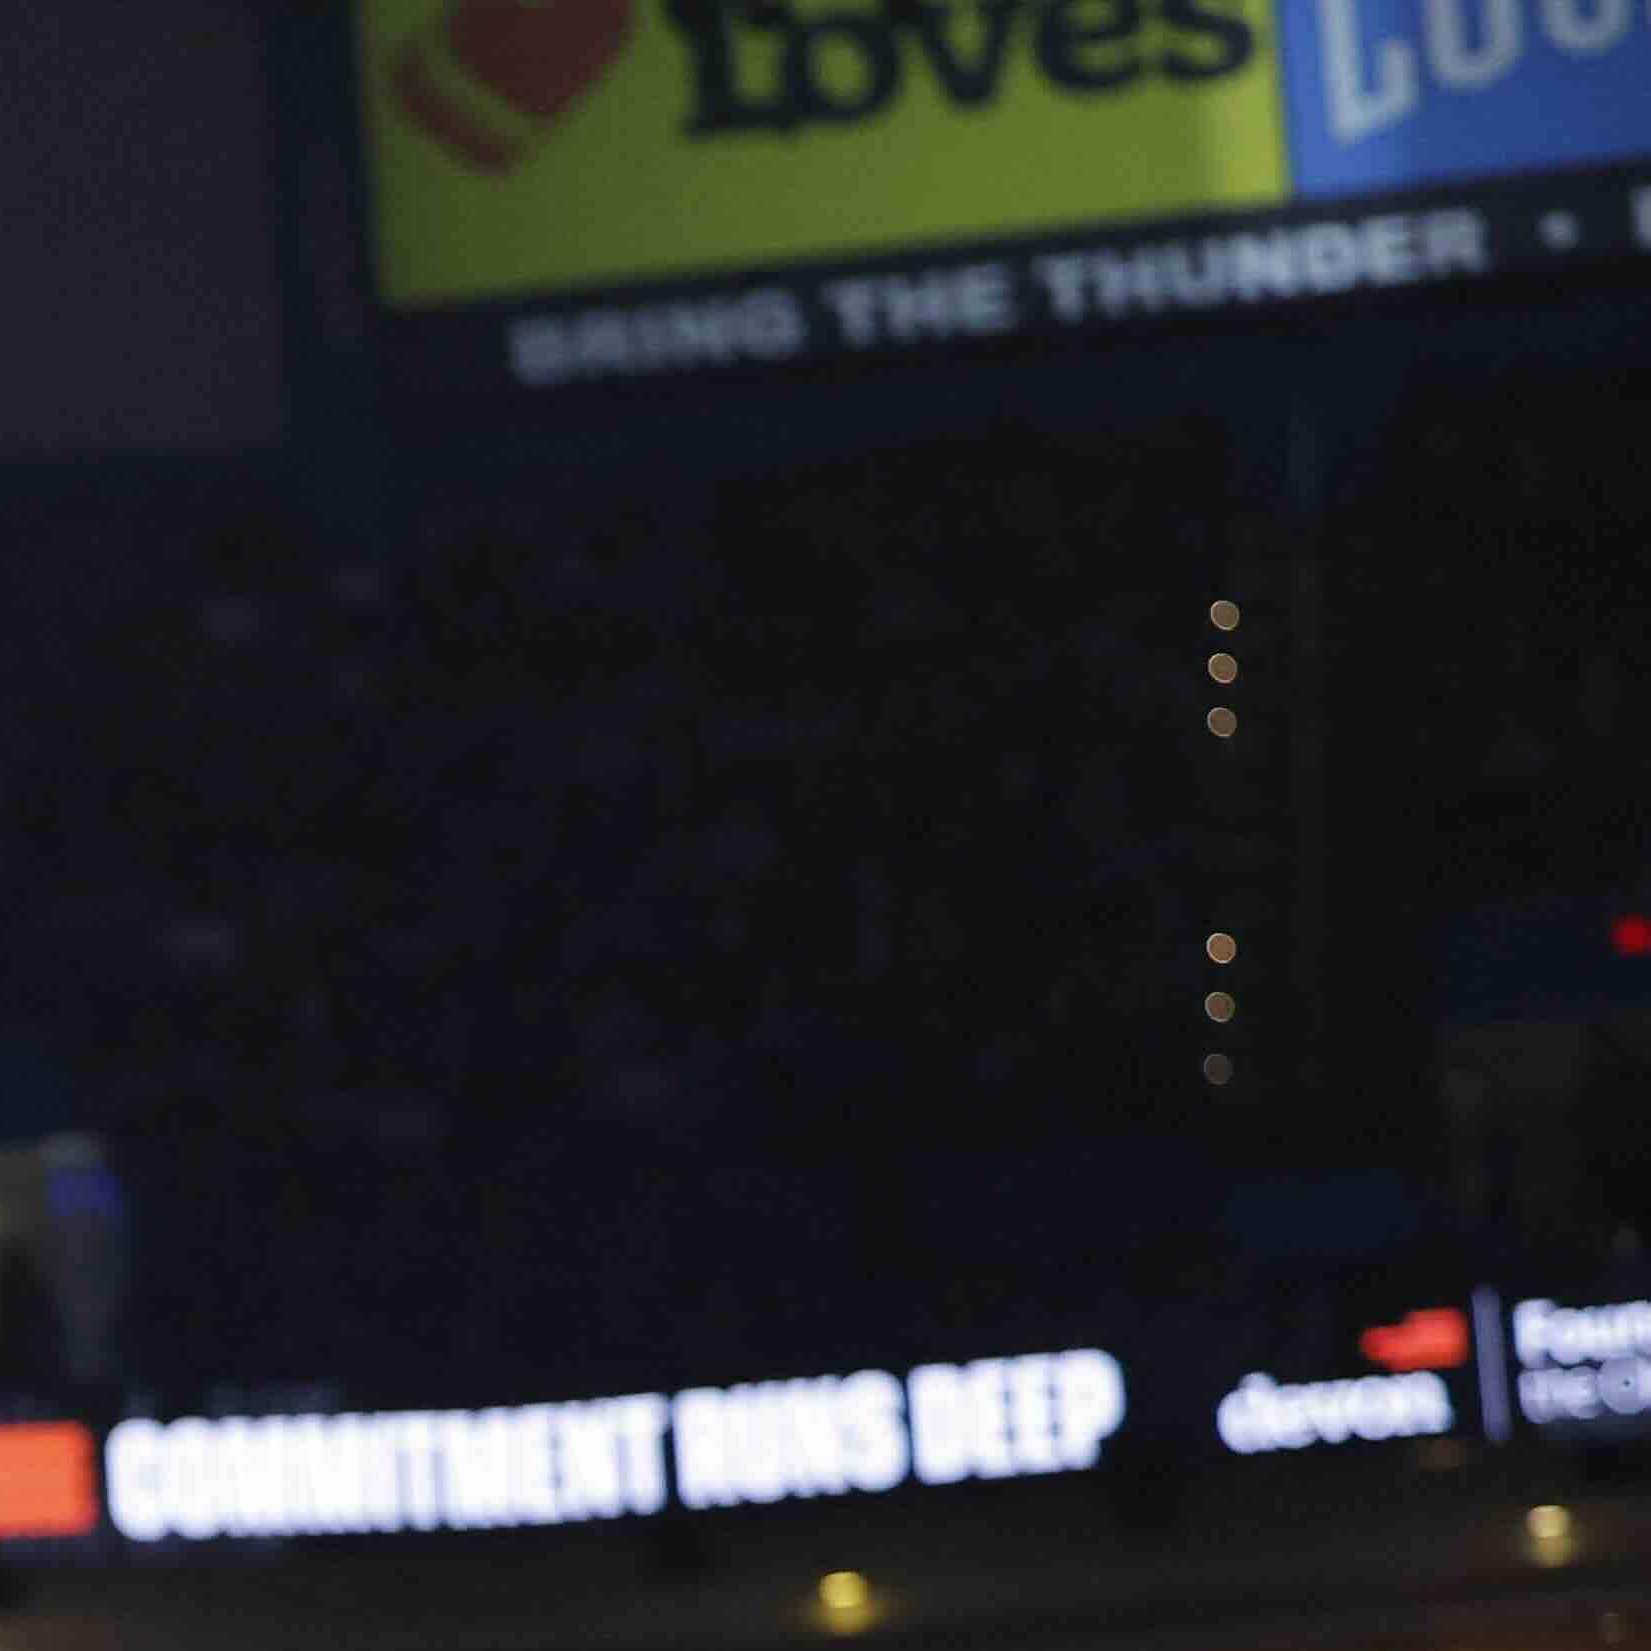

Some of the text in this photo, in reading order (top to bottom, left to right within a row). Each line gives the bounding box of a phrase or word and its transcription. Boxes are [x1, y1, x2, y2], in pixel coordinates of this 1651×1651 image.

[509, 206, 1489, 384] BRING THE THUNDER
[104, 1348, 1125, 1542] COMMITMENT RUNS DEEP
